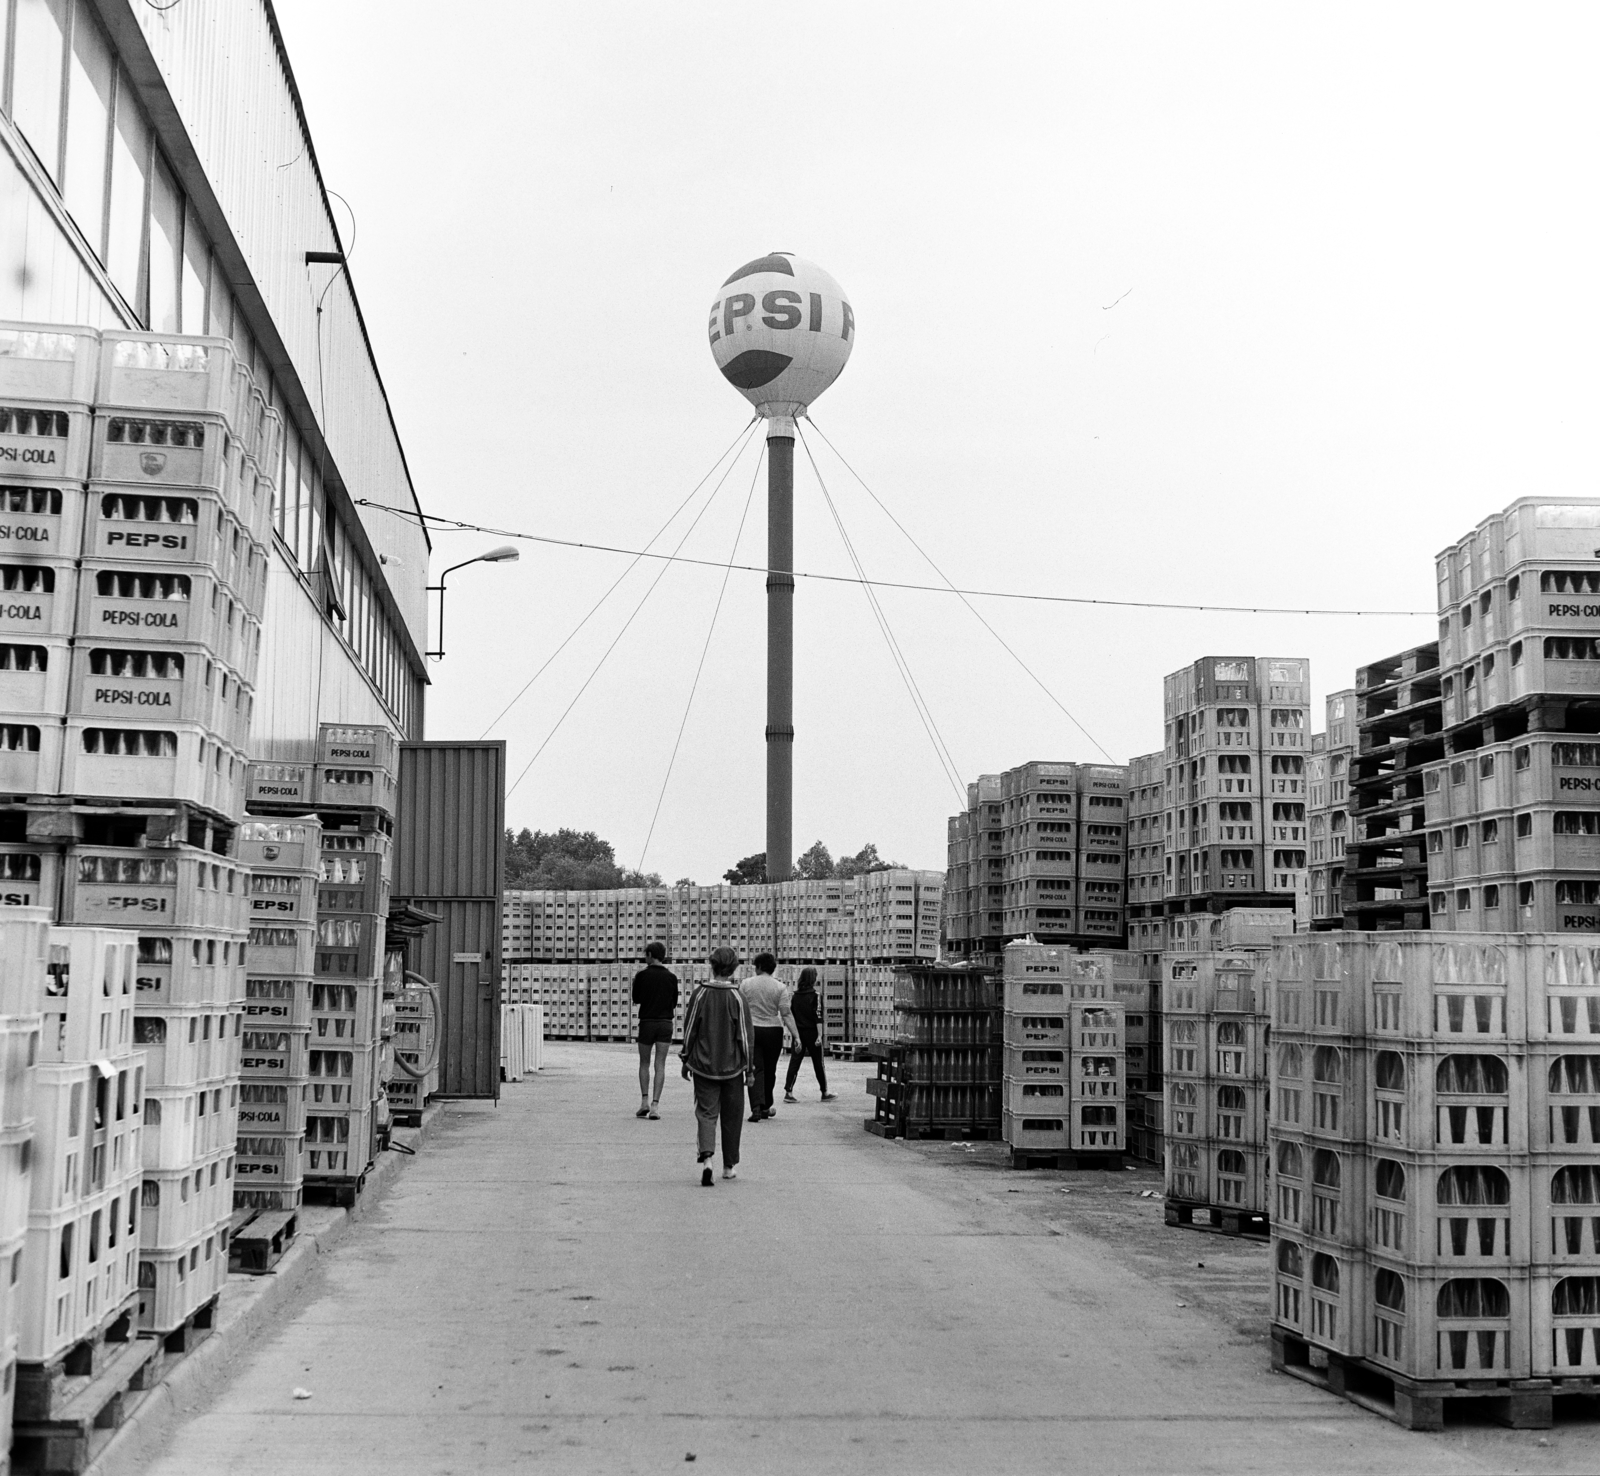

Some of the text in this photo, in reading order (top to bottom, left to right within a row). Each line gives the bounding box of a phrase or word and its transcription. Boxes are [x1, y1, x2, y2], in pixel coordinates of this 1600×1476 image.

[708, 288, 824, 346] EPSI
[108, 532, 188, 550] PEPSI
[0, 894, 30, 906] SI
[86, 896, 166, 912] EPSI
[250, 900, 294, 912] EPSI
[1564, 916, 1600, 928] PEPSI-
[240, 1058, 284, 1068] EPSI
[1026, 1066, 1060, 1074] PEPSI
[234, 1164, 278, 1174] EPSI
